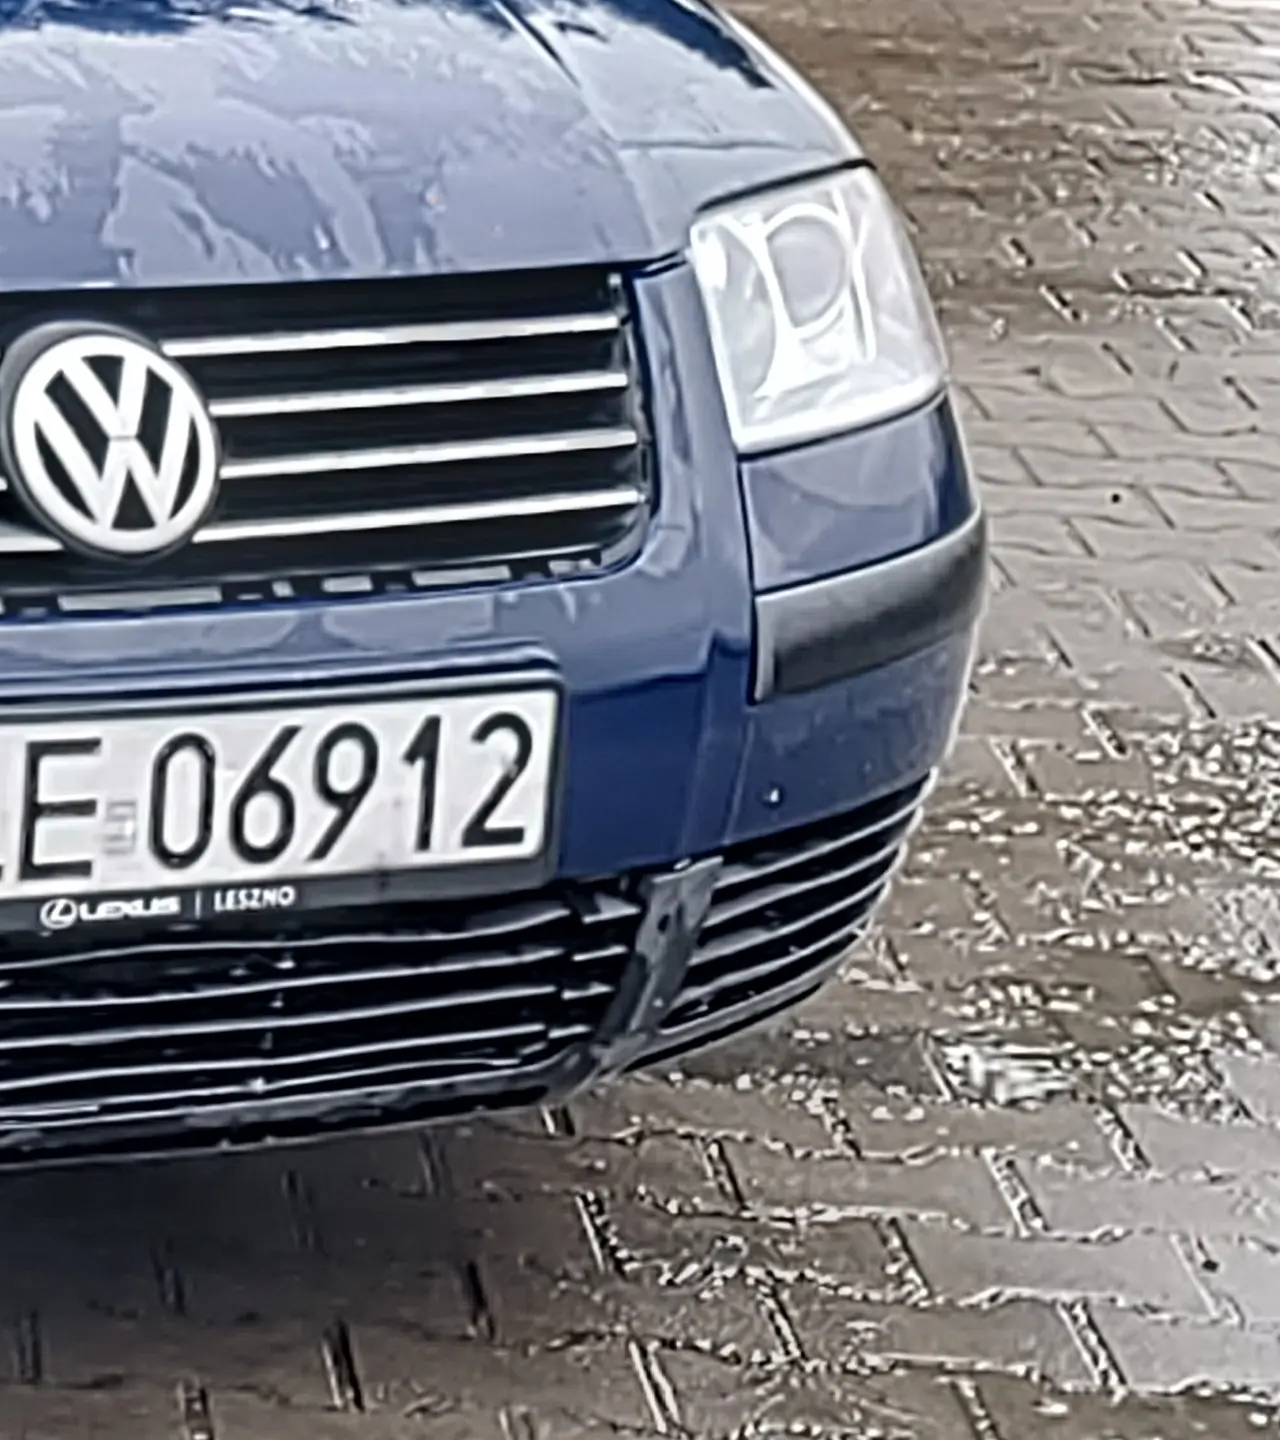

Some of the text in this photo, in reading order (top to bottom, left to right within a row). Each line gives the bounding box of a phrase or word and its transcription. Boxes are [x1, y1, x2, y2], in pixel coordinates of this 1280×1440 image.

[13, 334, 216, 553] VW
[146, 711, 533, 869] 06912
[79, 885, 295, 921] LEXUS LESZNO
